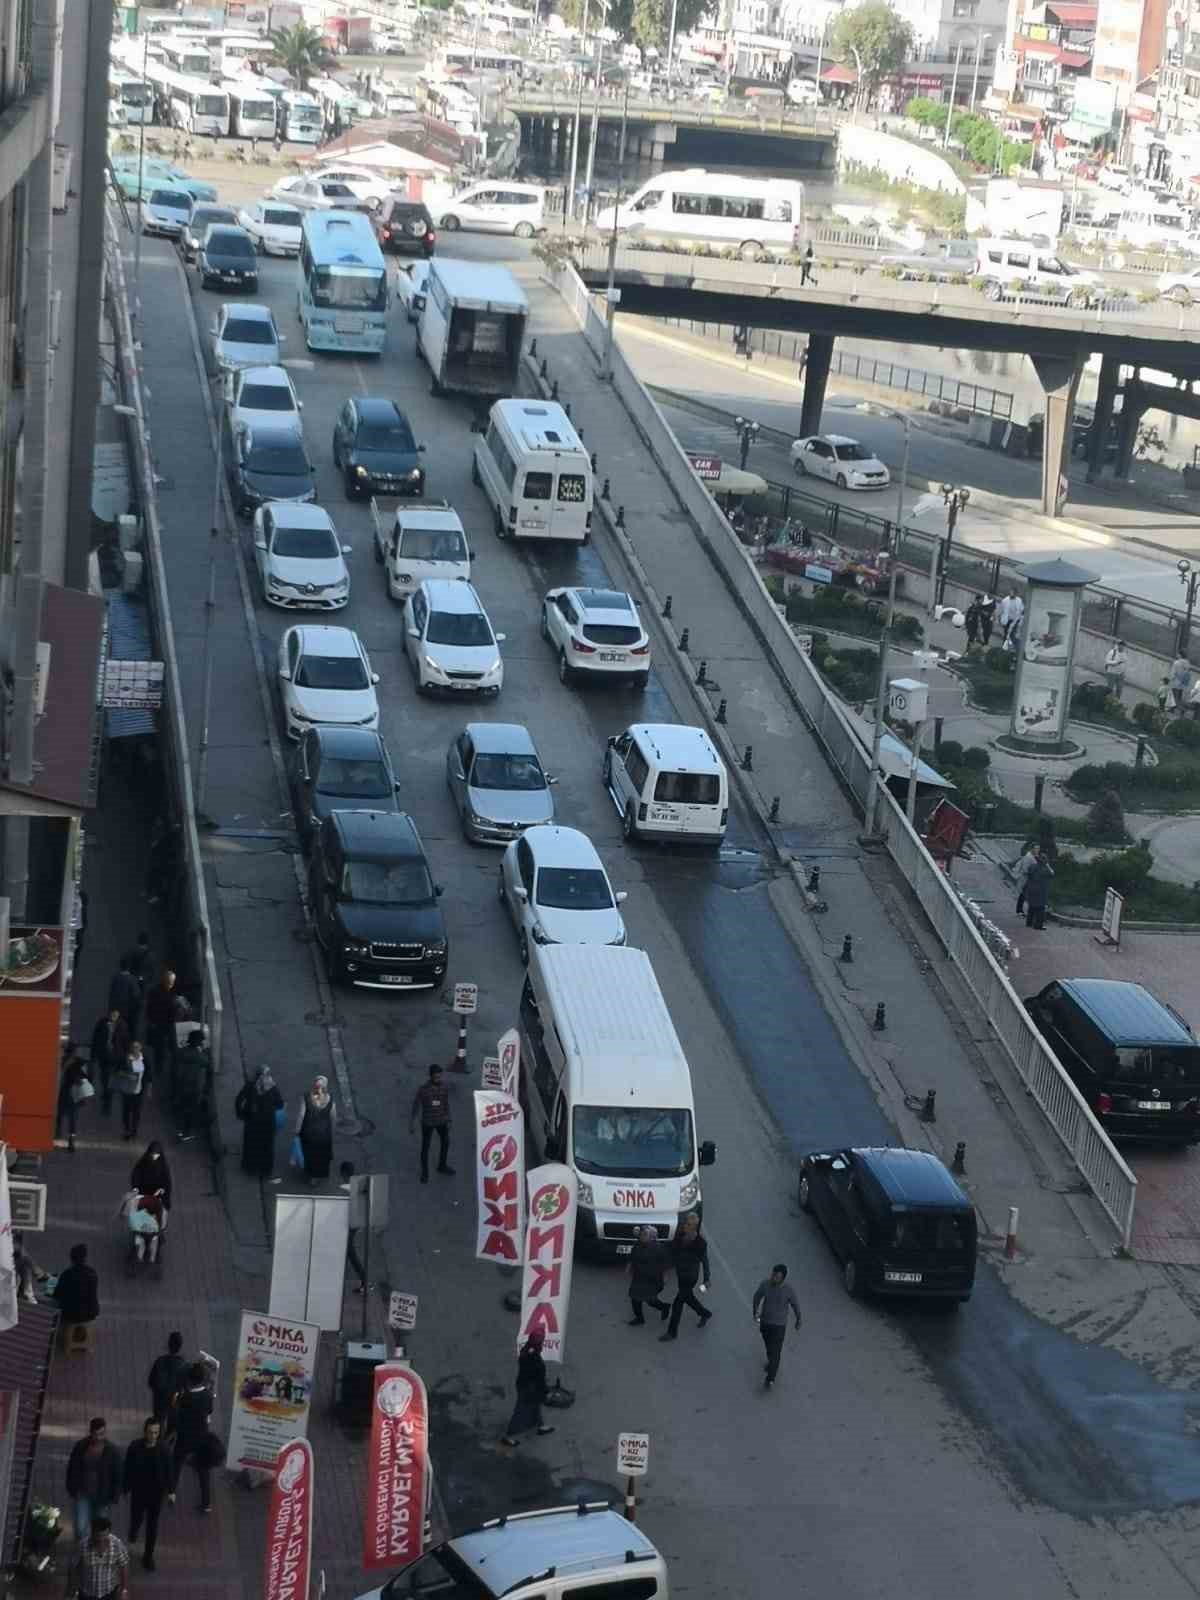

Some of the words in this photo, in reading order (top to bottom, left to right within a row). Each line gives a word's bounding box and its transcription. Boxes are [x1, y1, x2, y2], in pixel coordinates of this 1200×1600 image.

[613, 1189, 656, 1208] ONKA
[252, 1319, 305, 1344] ONKA
[247, 1335, 266, 1345] KIZ
[270, 1340, 308, 1355] YURDU
